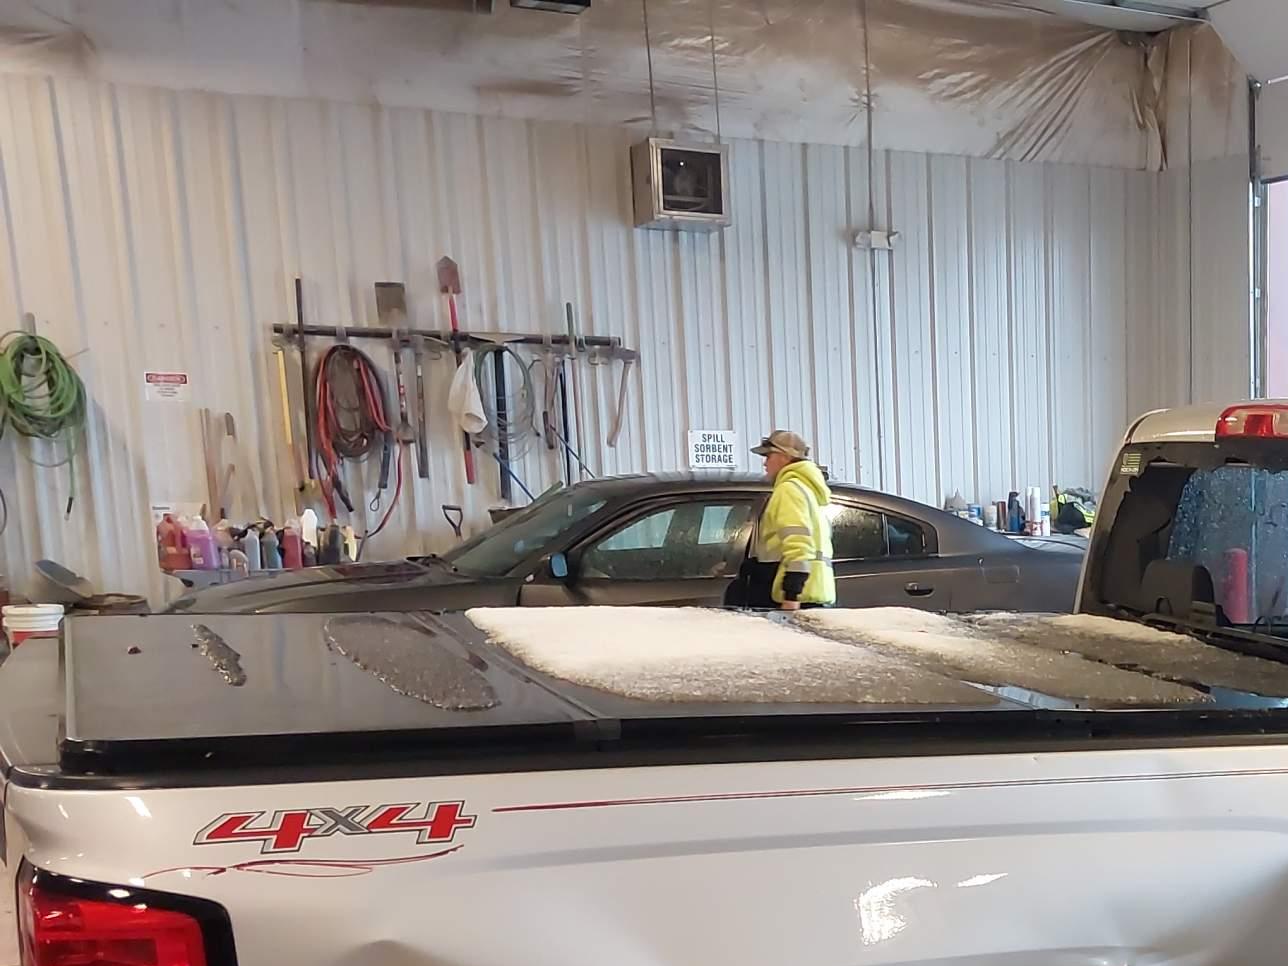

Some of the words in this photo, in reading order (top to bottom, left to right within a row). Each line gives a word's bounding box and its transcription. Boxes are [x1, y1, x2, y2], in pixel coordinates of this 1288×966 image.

[702, 433, 726, 443] SPILL
[694, 443, 734, 453] SORBENT
[695, 454, 734, 464] STORAGE
